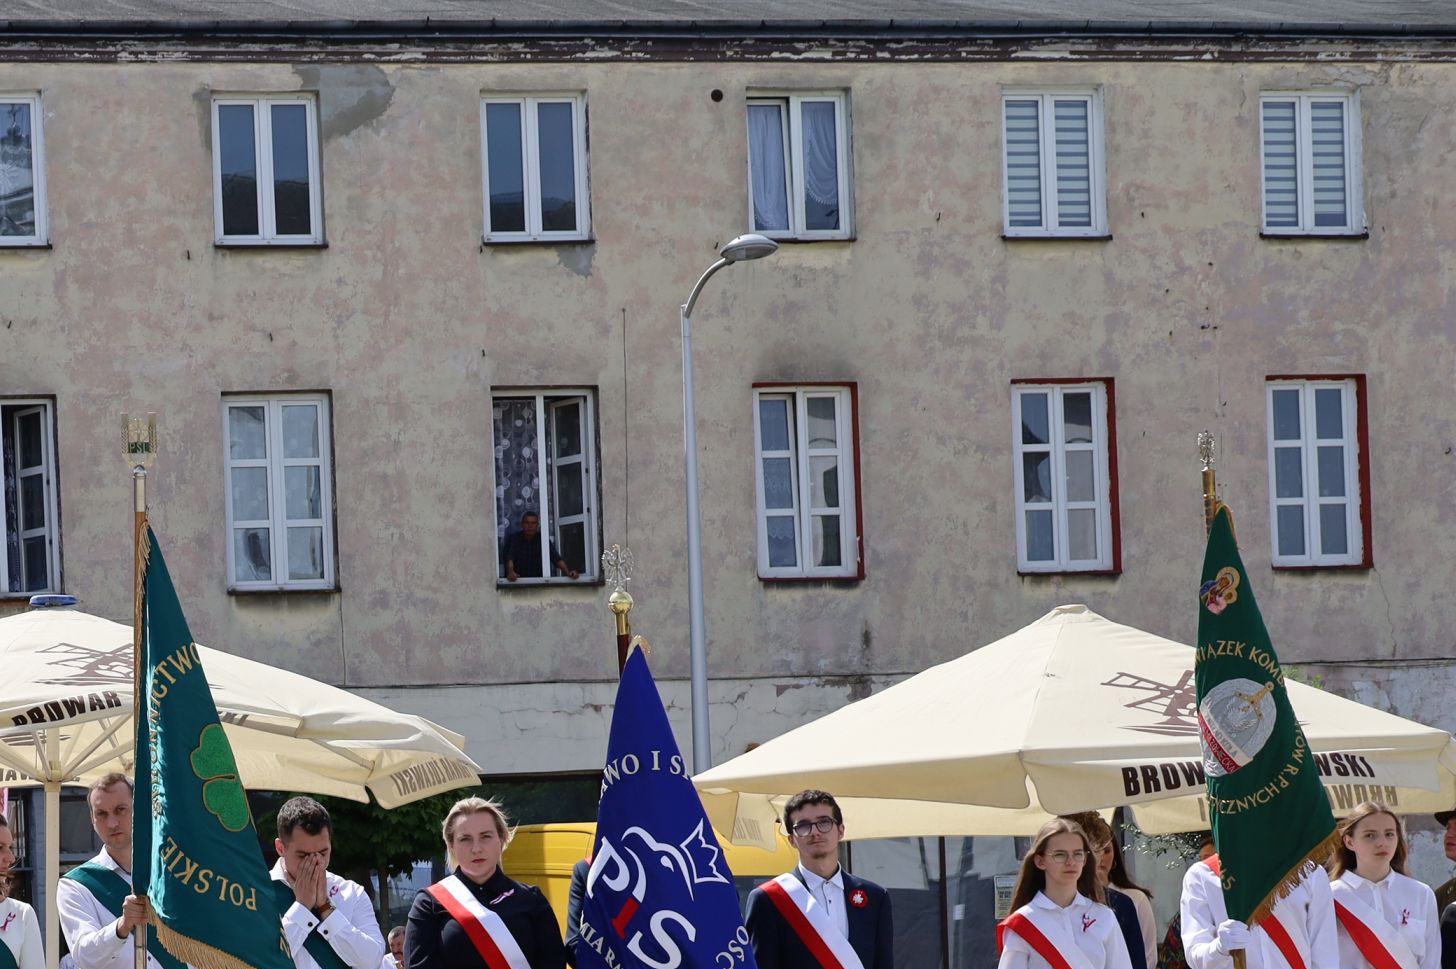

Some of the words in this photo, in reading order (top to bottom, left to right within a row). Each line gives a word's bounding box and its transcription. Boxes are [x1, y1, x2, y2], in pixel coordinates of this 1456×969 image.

[129, 442, 149, 454] PSL
[650, 750, 661, 771] I
[160, 836, 258, 911] POLSKIE
